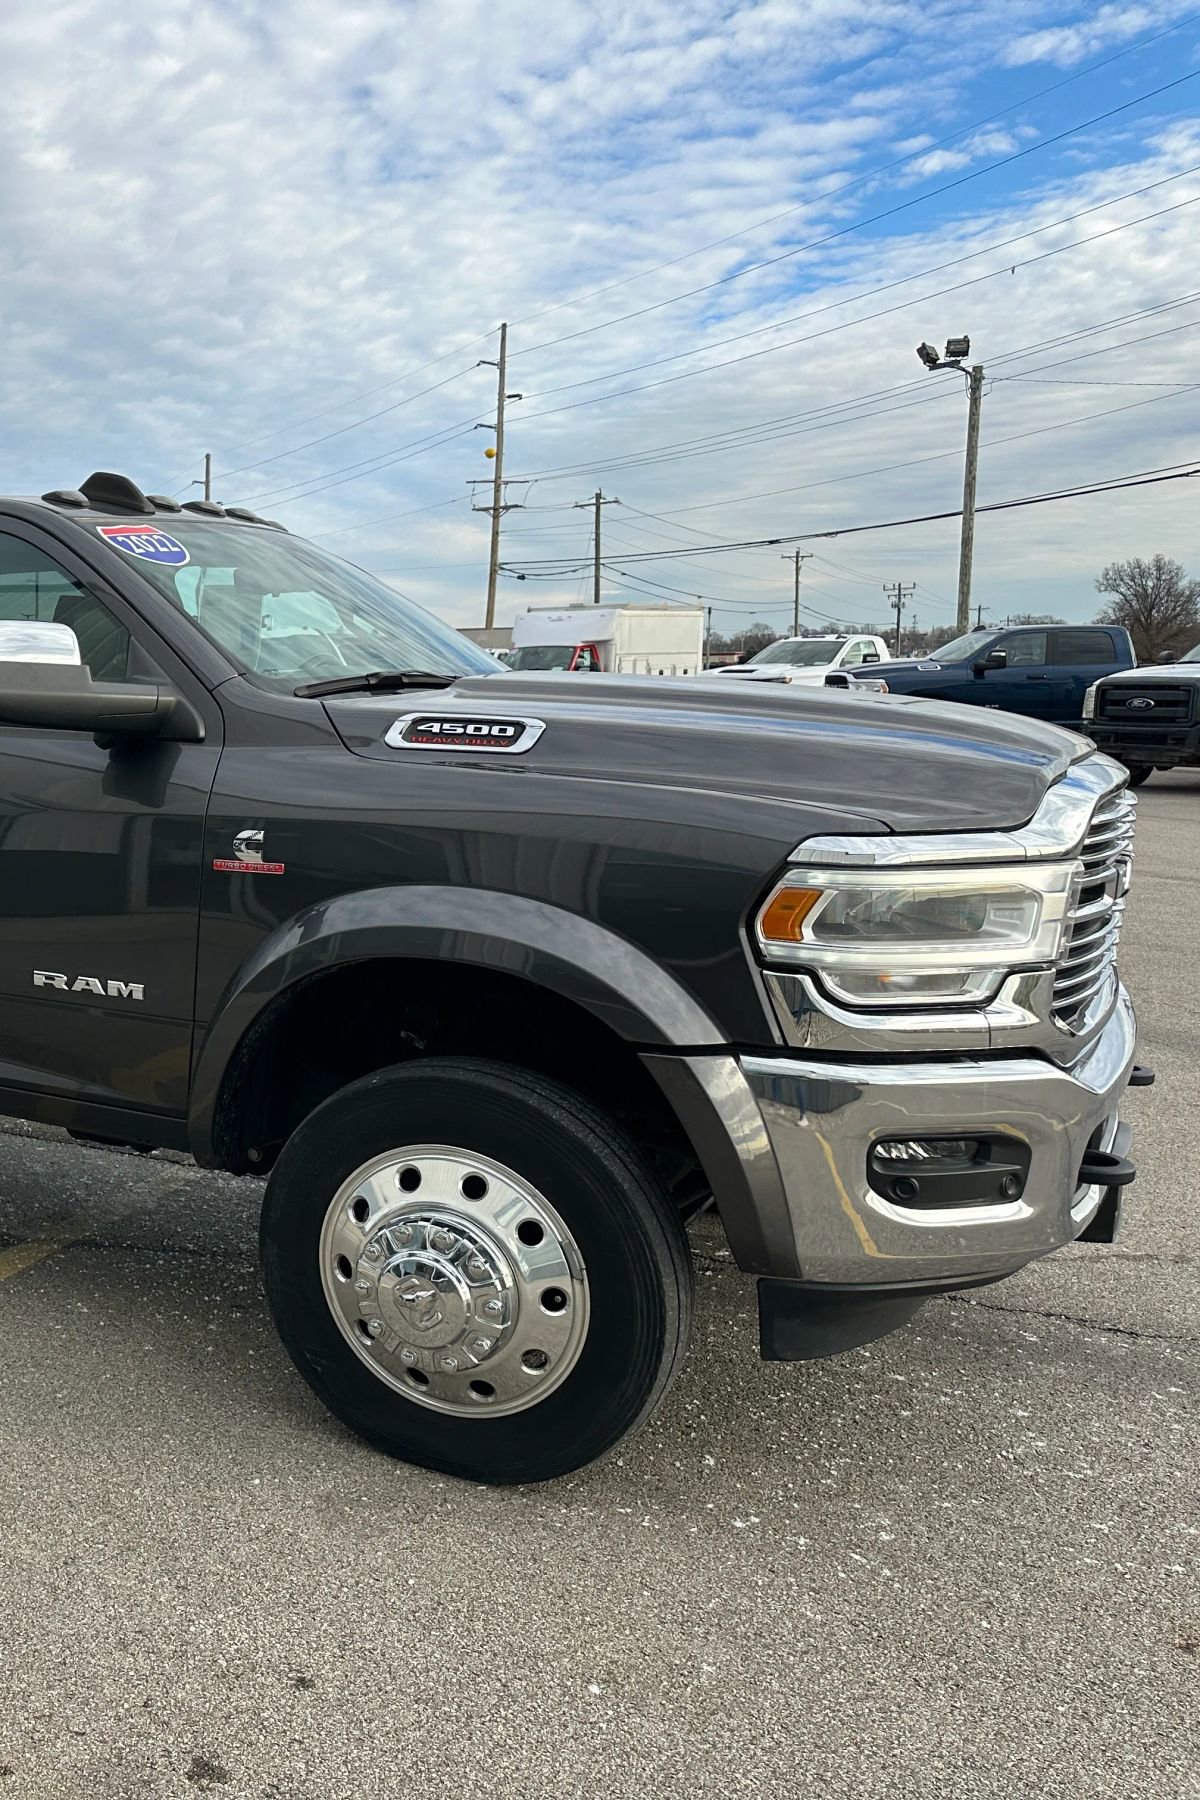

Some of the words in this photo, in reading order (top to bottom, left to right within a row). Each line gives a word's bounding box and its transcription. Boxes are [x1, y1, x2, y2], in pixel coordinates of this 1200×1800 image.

[116, 535, 182, 553] 2022
[417, 722, 515, 737] 4500
[215, 861, 246, 870] TURBO
[248, 864, 282, 872] DIESEL
[33, 970, 145, 1000] RAM
